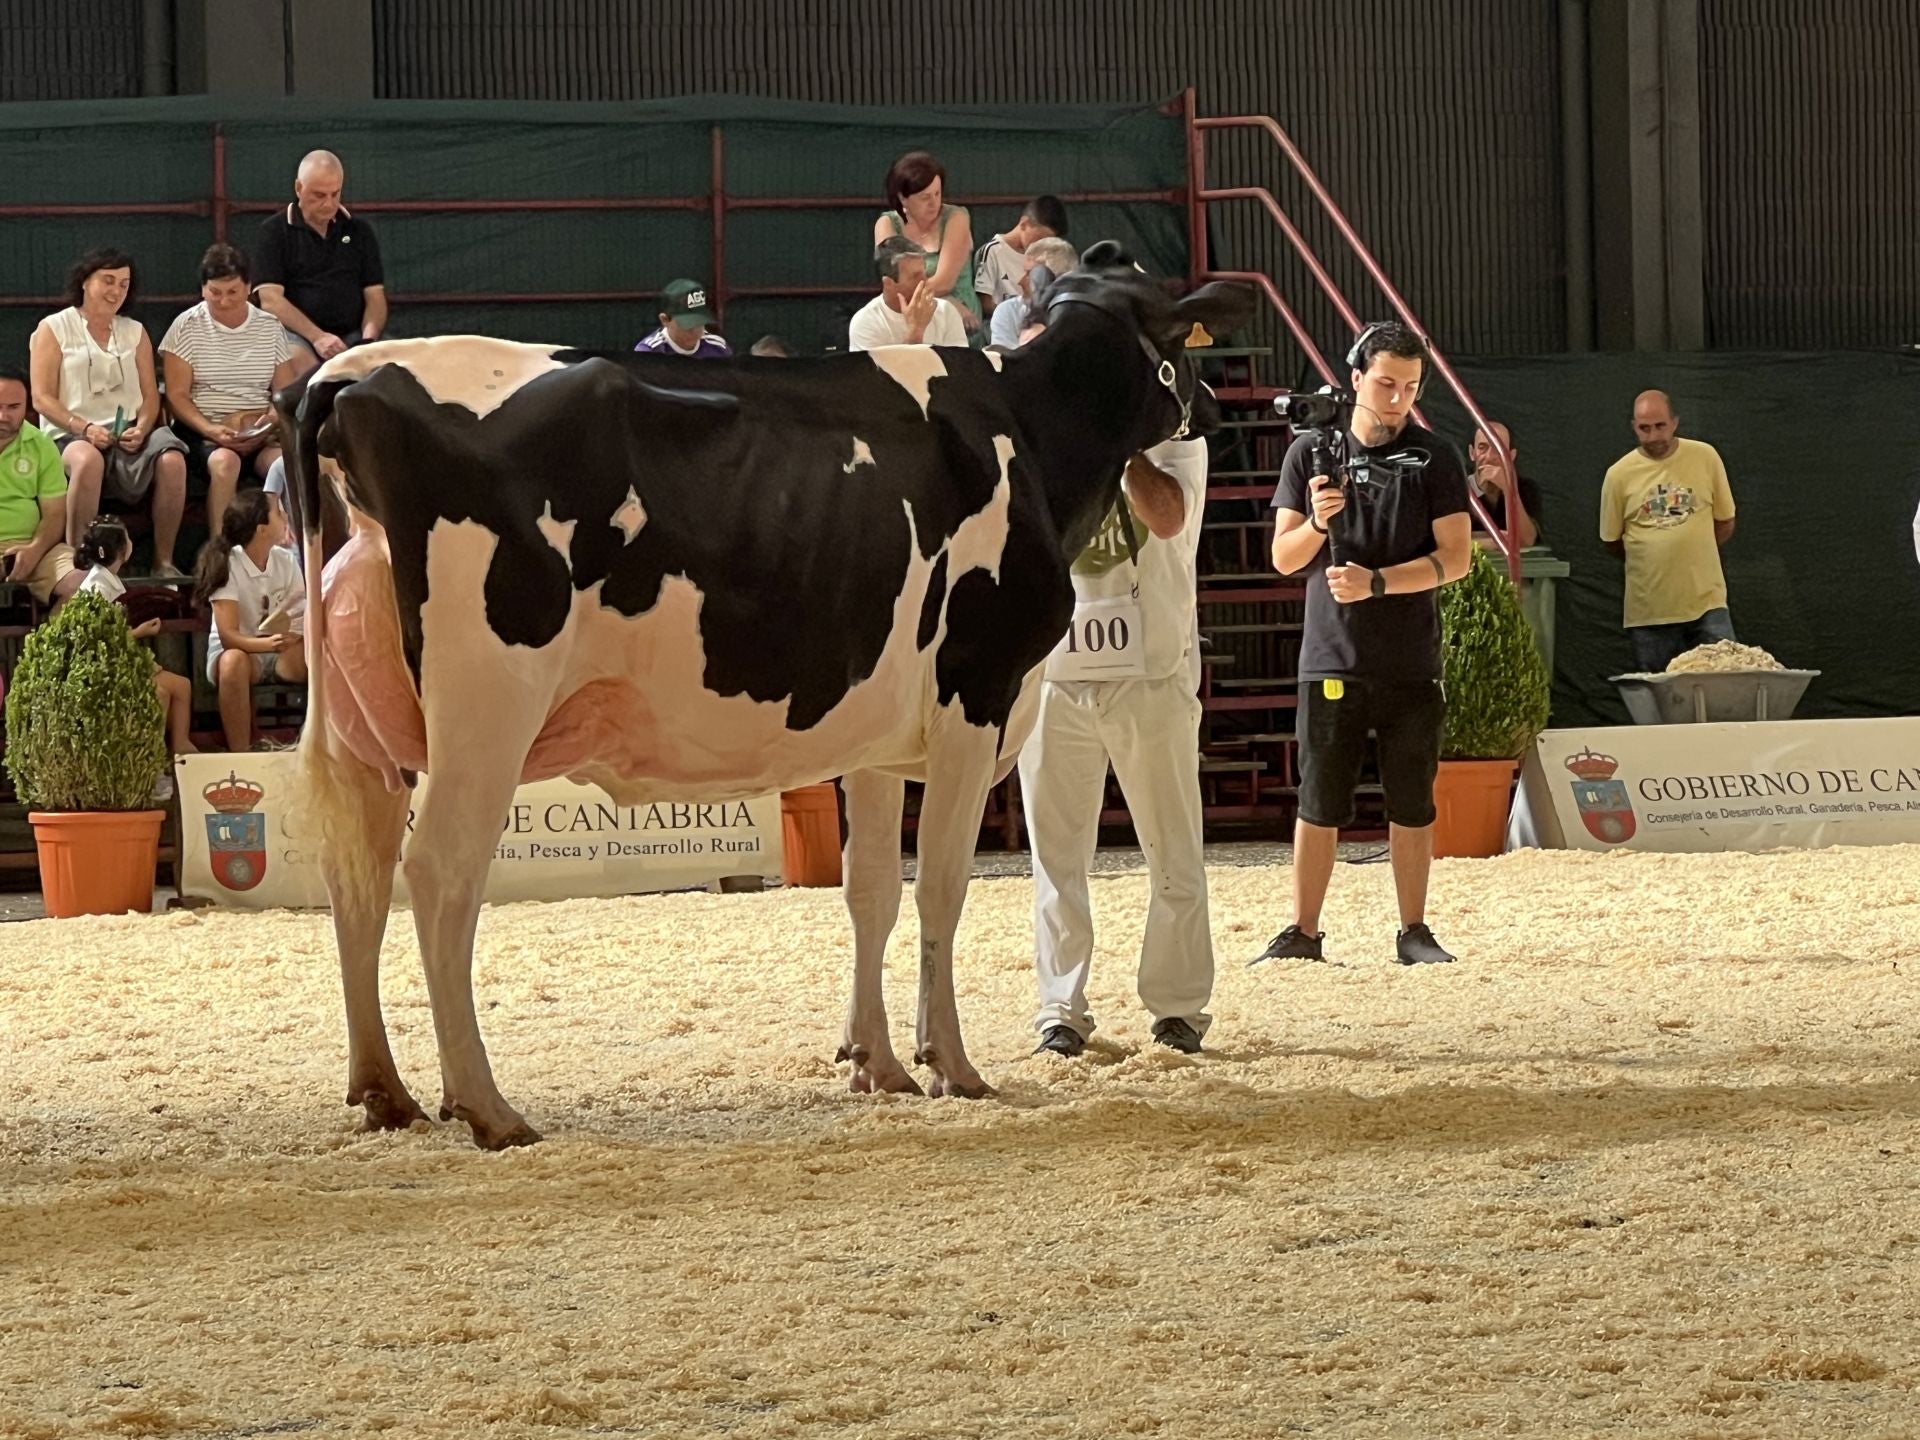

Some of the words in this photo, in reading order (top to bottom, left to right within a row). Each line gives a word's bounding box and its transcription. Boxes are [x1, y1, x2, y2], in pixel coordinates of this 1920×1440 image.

[1066, 616, 1129, 654] 100
[1638, 772, 1810, 802] GOBIERNO
[1817, 769, 1864, 794] DE
[543, 801, 756, 833] CANTABRIA
[1705, 809, 1719, 820] de
[1720, 806, 1774, 819] Desarrollo
[1868, 800, 1904, 812] Pesca,
[530, 842, 582, 858] Pesca
[588, 845, 599, 861] y
[607, 838, 703, 857] Desarrollo
[711, 836, 760, 853] Rural
